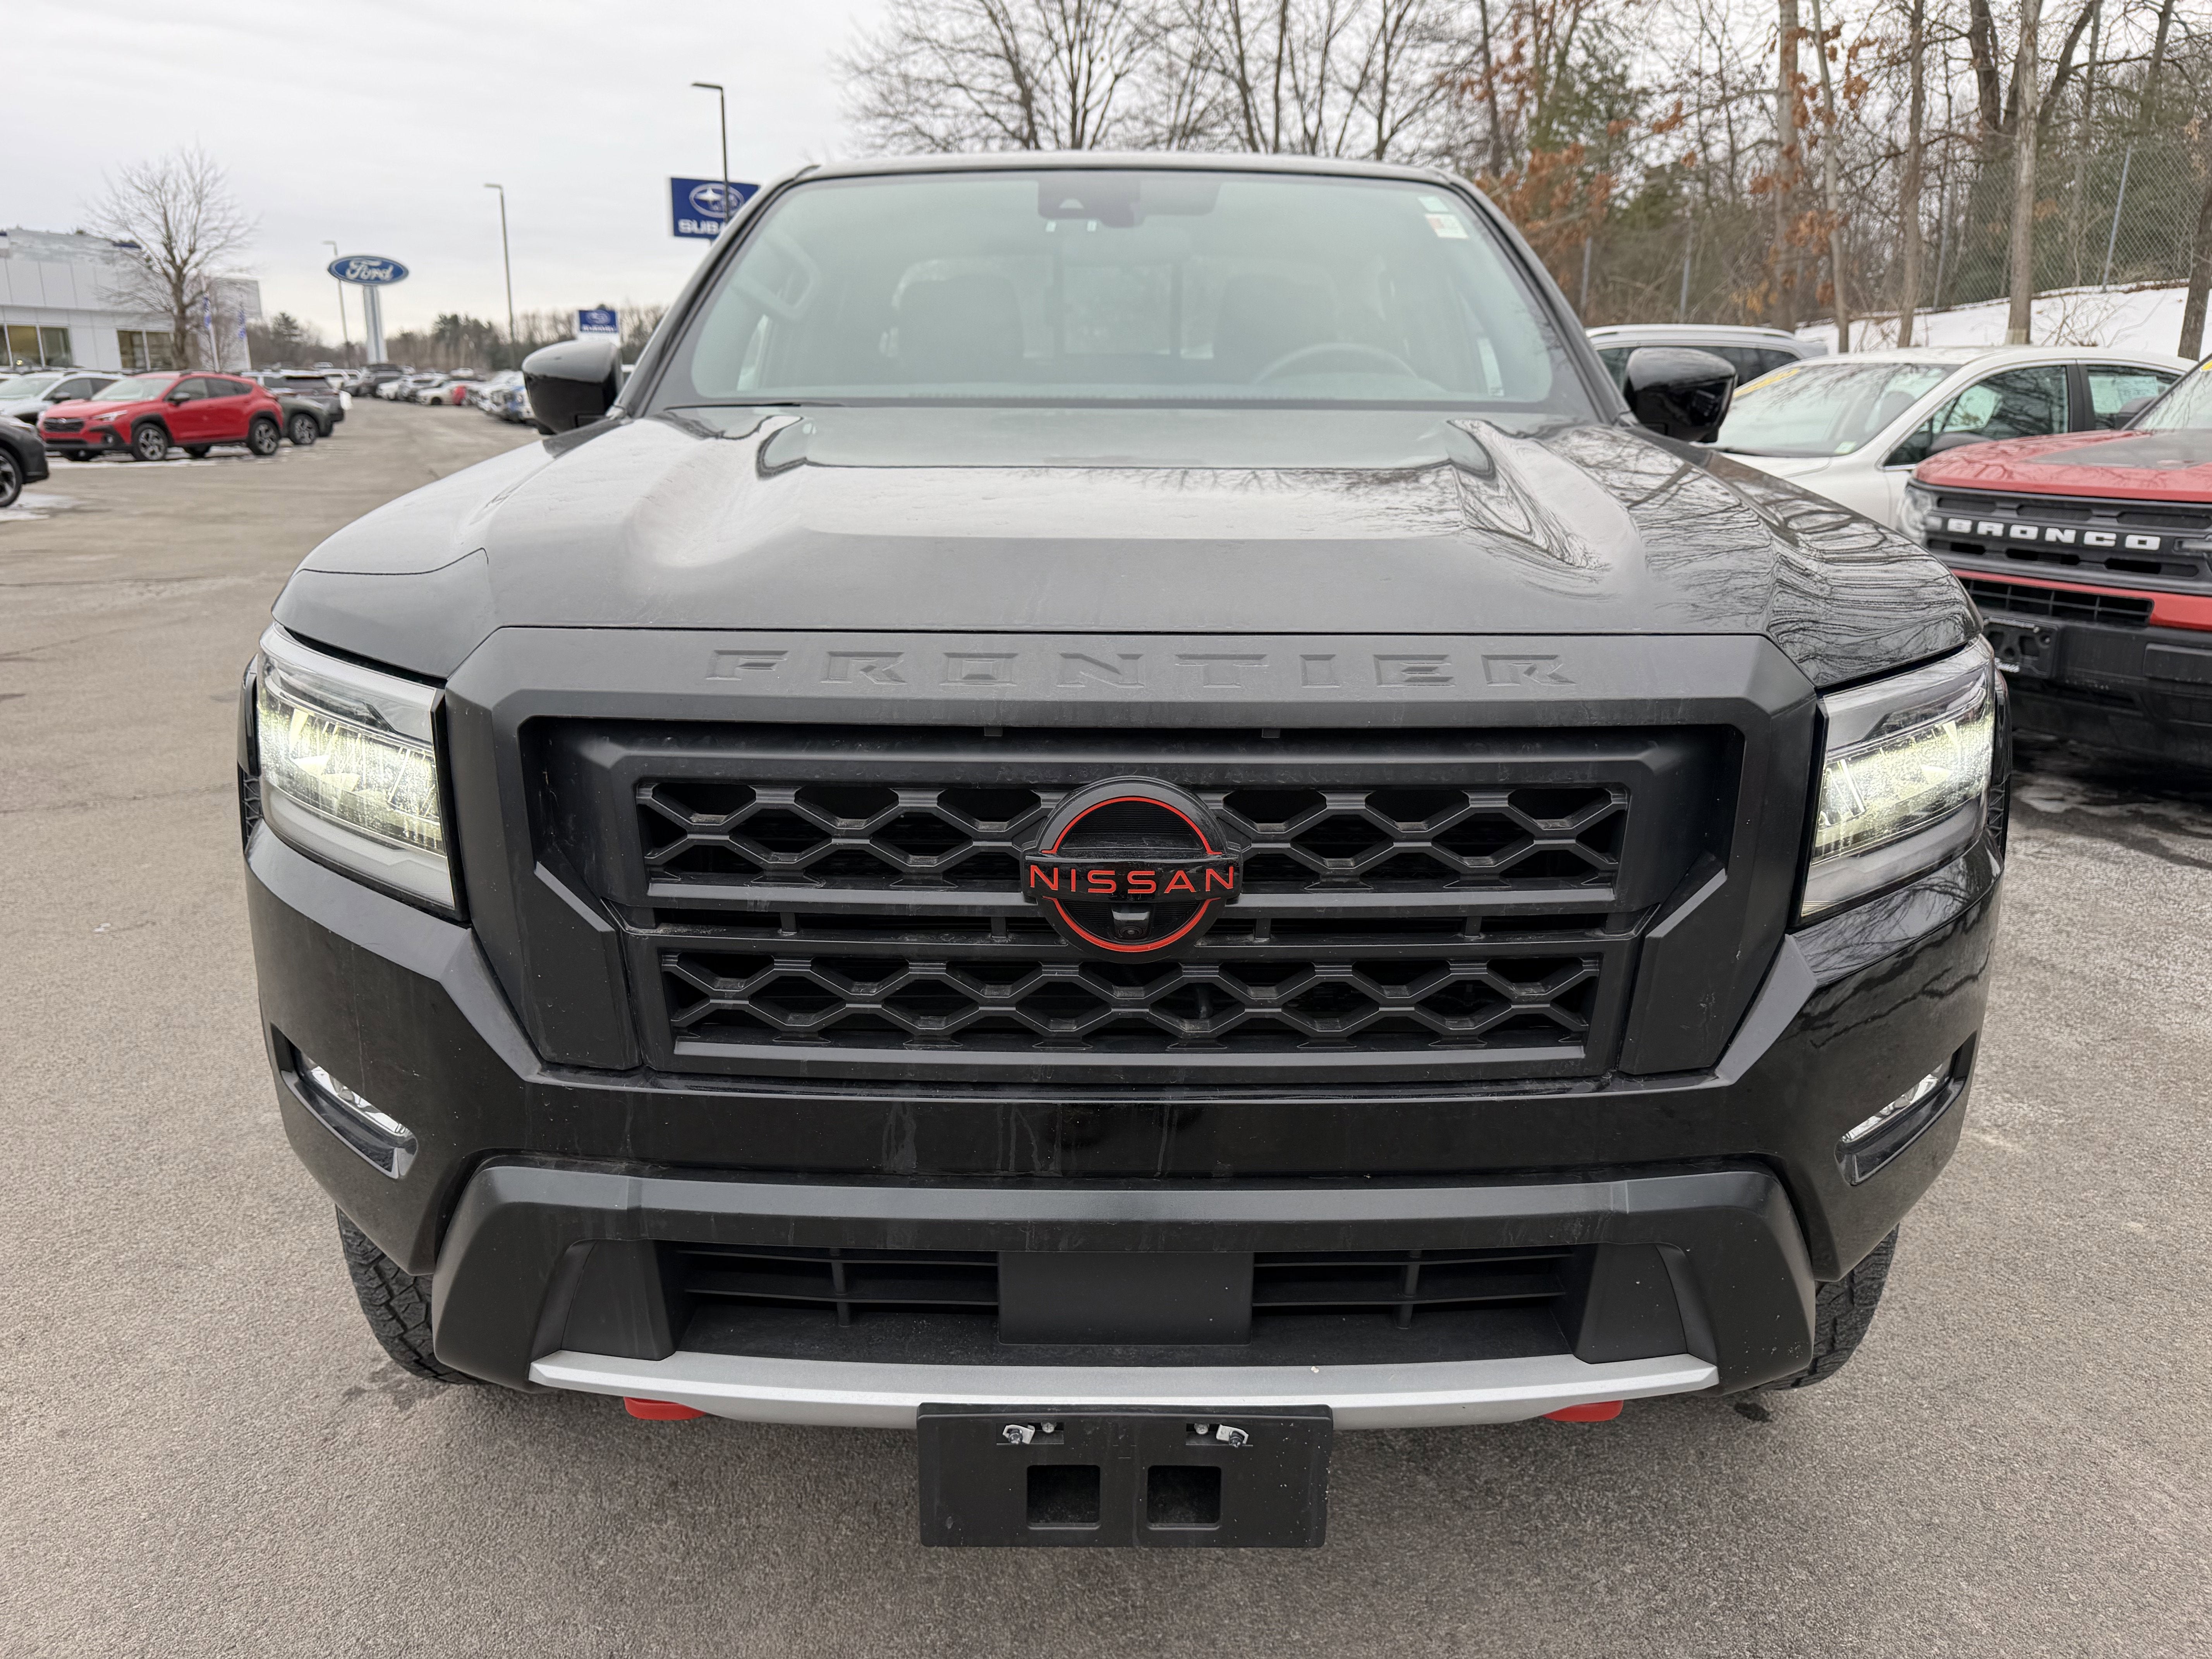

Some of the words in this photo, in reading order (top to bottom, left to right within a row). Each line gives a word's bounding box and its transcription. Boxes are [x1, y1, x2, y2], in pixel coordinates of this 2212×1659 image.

[345, 258, 394, 282] Ford
[1947, 518, 2161, 551] BRONCO
[705, 649, 1577, 687] FRONTIER
[1030, 864, 1234, 894] NISSAN
